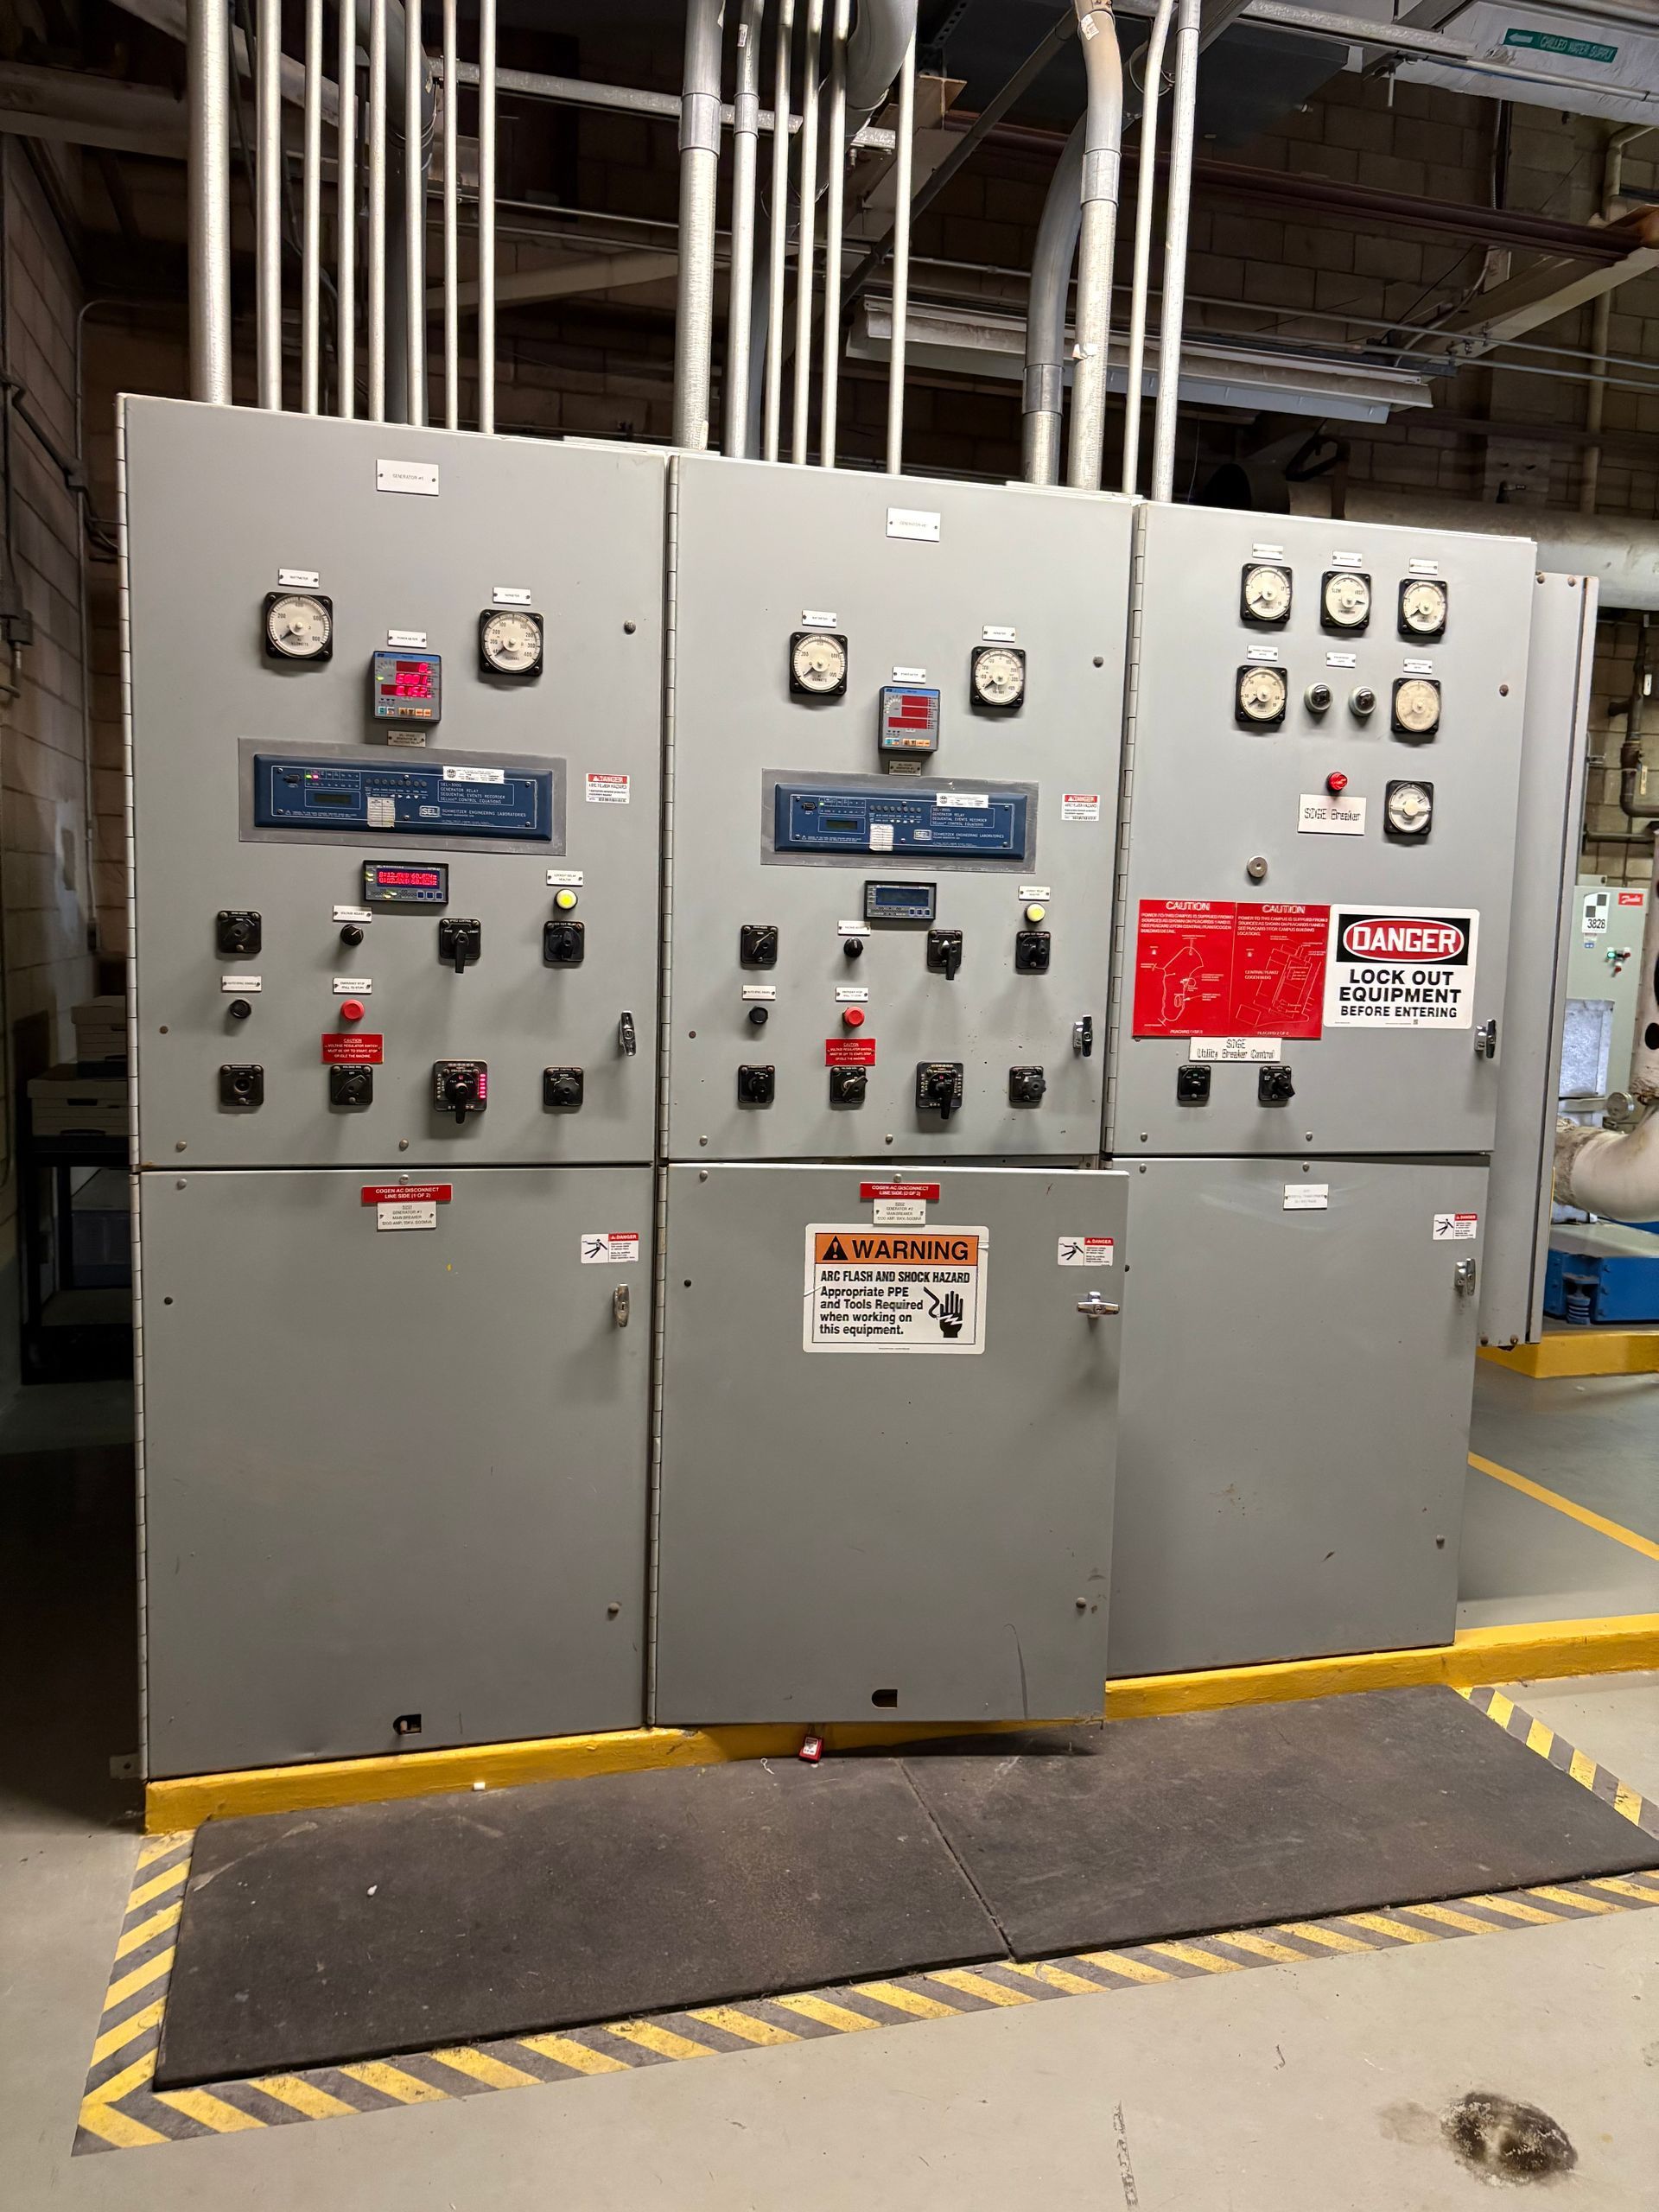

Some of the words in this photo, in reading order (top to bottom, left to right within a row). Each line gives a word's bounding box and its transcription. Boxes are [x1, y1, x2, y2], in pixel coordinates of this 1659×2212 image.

[422, 807, 437, 816] SEL
[1331, 808, 1361, 821] Breaker
[1166, 900, 1210, 911] CAUTION
[1262, 904, 1306, 914] CAUTION
[1587, 918, 1606, 929] 3828
[1352, 926, 1456, 953] DANGER
[1350, 969, 1405, 985] LOCK
[1412, 970, 1454, 986] OUT
[1339, 987, 1462, 1003] EQUIPMENT
[1341, 1006, 1390, 1017] BEFORE
[1395, 1007, 1457, 1018] ENTERING
[1198, 1048, 1218, 1060] Utility
[1222, 1049, 1248, 1059] Breaker
[1251, 1049, 1275, 1059] Control
[852, 1239, 969, 1261] WARNING
[821, 1270, 840, 1282] ARC
[843, 1270, 873, 1282] FLASH
[876, 1271, 895, 1282] AND
[899, 1271, 930, 1283] SHOCK
[933, 1272, 970, 1283] HAZARD
[821, 1286, 885, 1300] Appropriate
[887, 1287, 909, 1297] PPE
[821, 1299, 841, 1310] and
[843, 1299, 872, 1310] Tools
[875, 1300, 924, 1313] Required
[820, 1313, 849, 1322] when
[853, 1312, 896, 1326] working
[899, 1314, 912, 1323] on
[820, 1324, 841, 1335] this
[843, 1325, 904, 1338] equipment.
